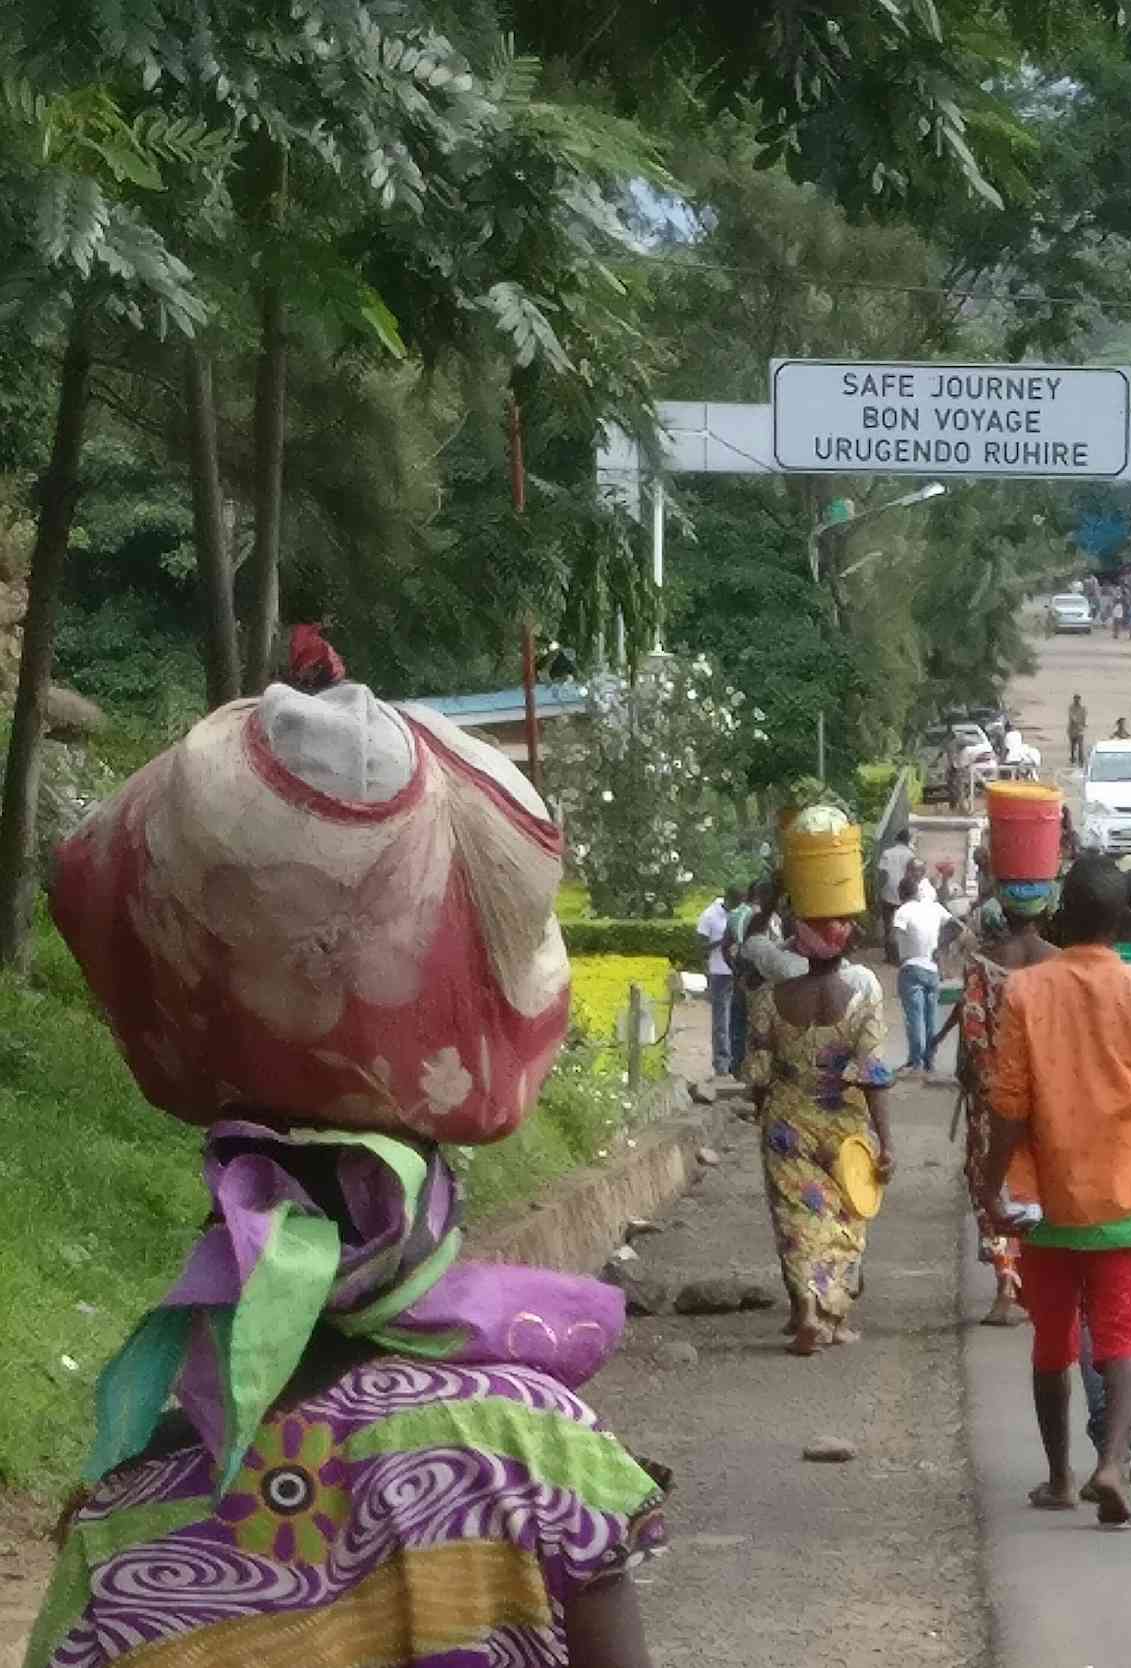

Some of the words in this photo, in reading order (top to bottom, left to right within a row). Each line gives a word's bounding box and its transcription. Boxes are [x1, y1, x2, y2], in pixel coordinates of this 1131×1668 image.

[842, 372, 915, 398] SAFE
[931, 374, 1062, 400] JOURNEY
[863, 406, 920, 430] BON
[934, 408, 1041, 433] VOYAGE
[815, 437, 970, 464] URUGENDO
[984, 441, 1088, 467] RUHIRE
